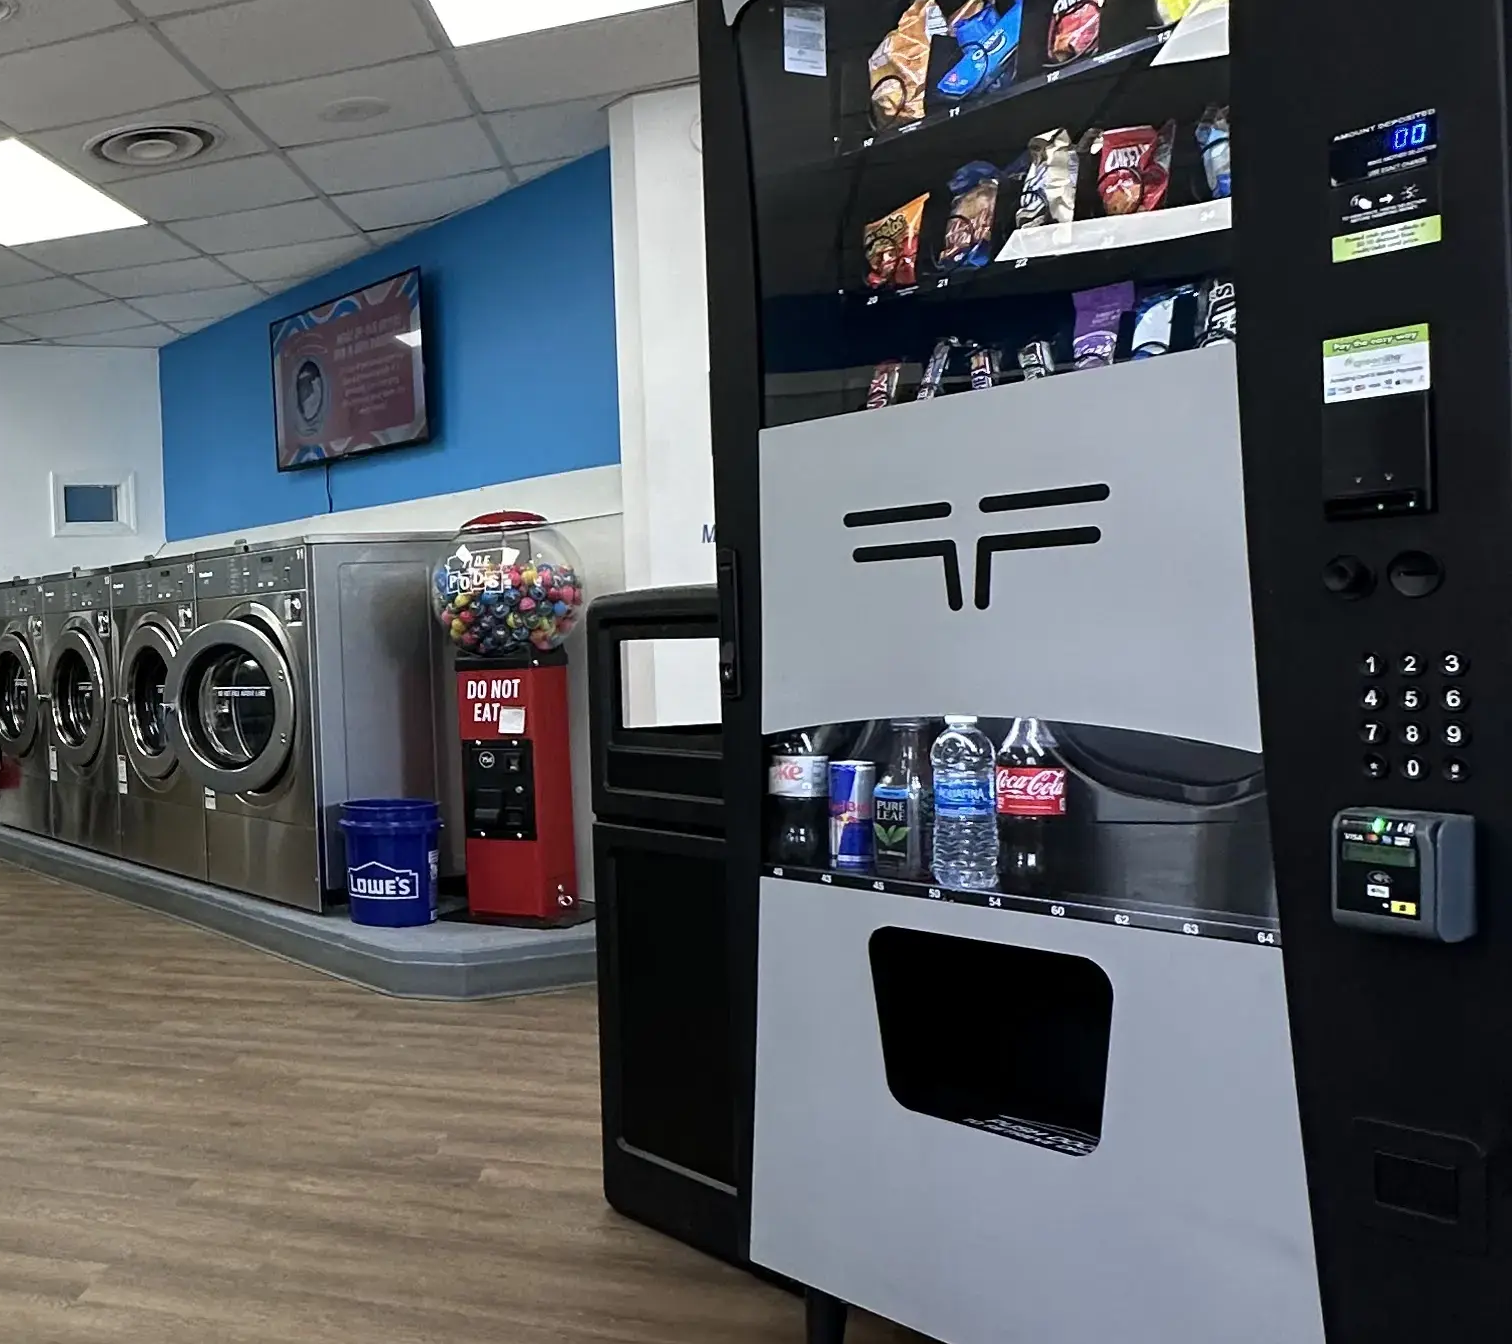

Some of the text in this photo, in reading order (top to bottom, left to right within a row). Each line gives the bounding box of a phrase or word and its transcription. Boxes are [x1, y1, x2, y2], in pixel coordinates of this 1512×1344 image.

[1157, 30, 1171, 43] 13
[1046, 70, 1060, 83] 12
[1333, 108, 1436, 143] AMOUNT DEPOSITED
[1401, 156, 1427, 168] CHANGE
[936, 278, 949, 288] 21
[1333, 331, 1419, 352] Pay the easy way
[296, 548, 304, 560] 11
[449, 570, 499, 590] PODS
[1366, 654, 1460, 673] 1 2 3
[466, 678, 521, 699] DO NOT
[1364, 689, 1461, 707] 4 5 6
[473, 703, 500, 722] EAT
[1365, 724, 1462, 743] 7 8 9
[1407, 759, 1419, 776] 0
[996, 769, 1065, 796] Coca-Cola
[940, 786, 987, 801] AQUAFINA
[876, 800, 905, 811] PURE
[876, 810, 905, 822] LEAF
[1344, 833, 1364, 841] VISA
[350, 874, 411, 895] LOWE'S
[989, 898, 1002, 907] 54
[1050, 906, 1065, 916] 60
[1114, 914, 1130, 925] 62
[1183, 923, 1199, 935] 63
[1257, 932, 1274, 944] 64
